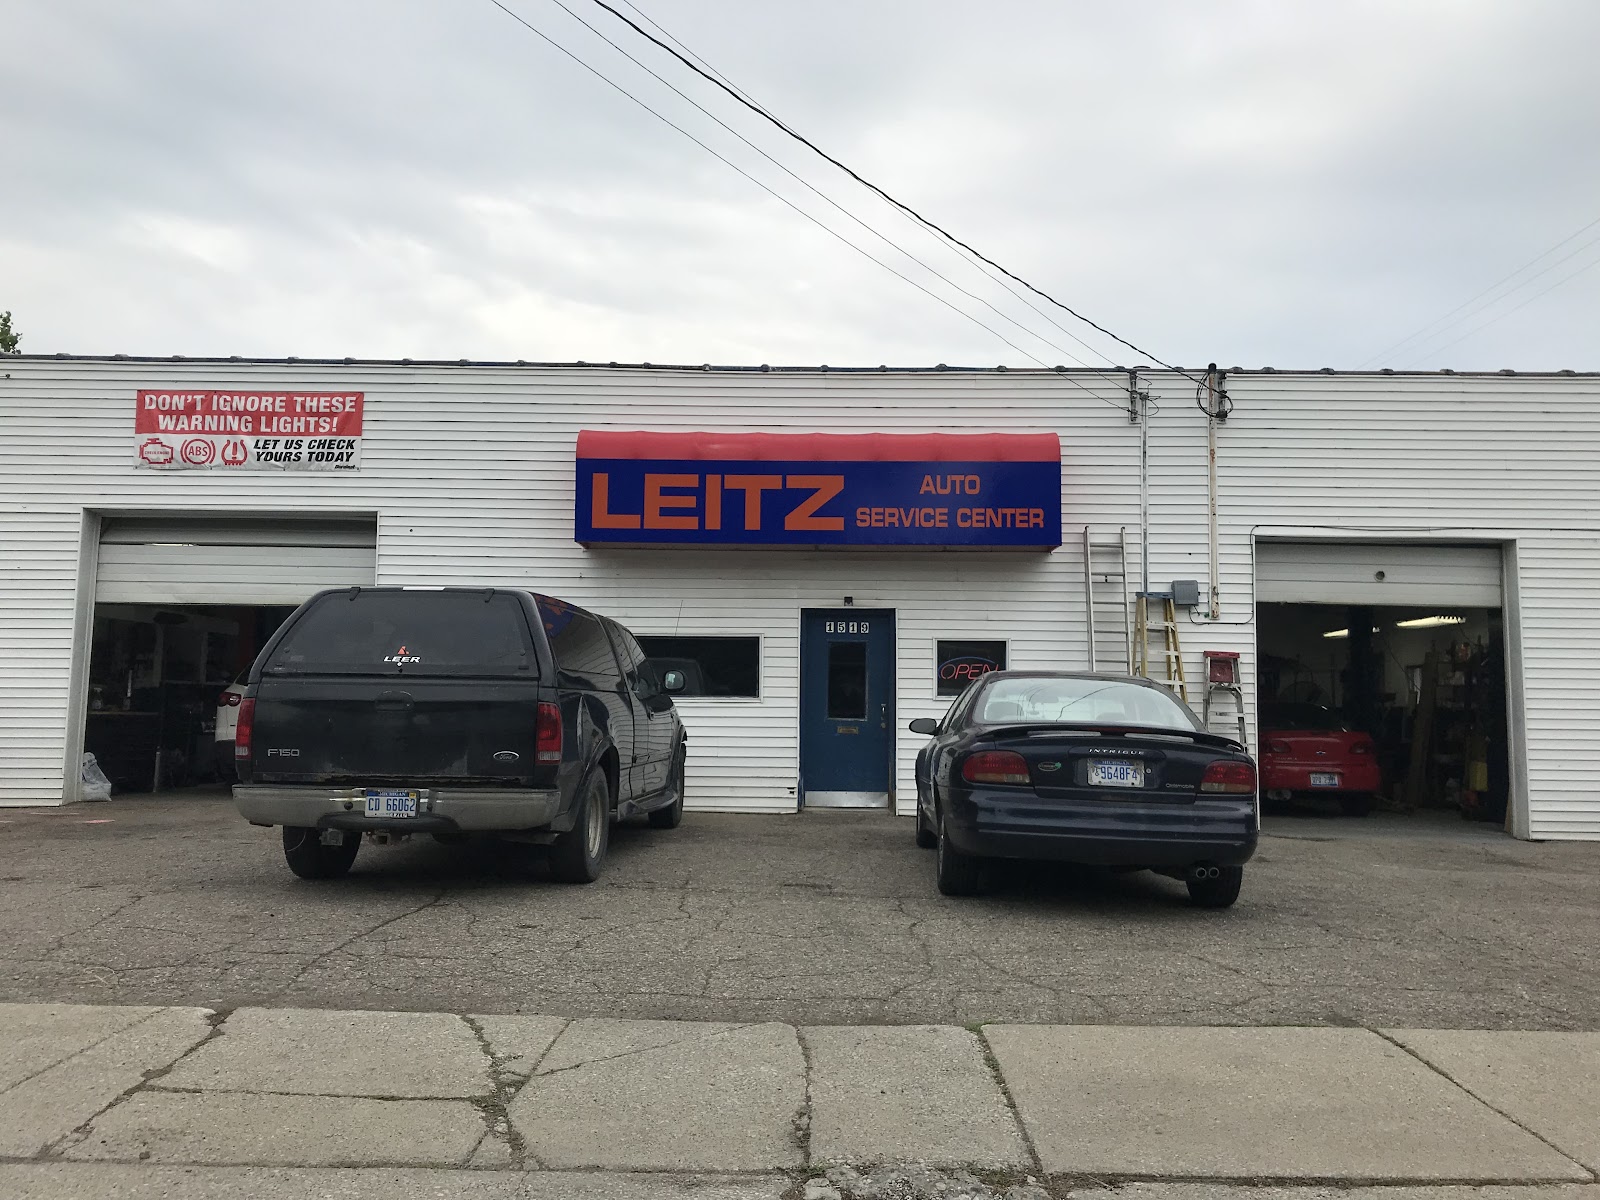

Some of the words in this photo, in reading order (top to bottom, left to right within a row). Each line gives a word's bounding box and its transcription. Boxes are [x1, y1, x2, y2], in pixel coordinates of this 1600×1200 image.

[144, 394, 205, 411] DON'T
[212, 395, 287, 412] IGNORE
[293, 396, 357, 413] THESE
[158, 415, 253, 432] WARNING
[260, 416, 338, 433] LIGHTS!
[188, 445, 208, 458] ABS
[253, 439, 281, 450] LET
[283, 439, 302, 450] US
[307, 439, 356, 450] CHECK
[255, 451, 301, 463] YOURS
[306, 451, 355, 463] TODAY
[919, 474, 980, 495] AUTO
[591, 472, 845, 531] LEITZ
[855, 508, 948, 528] SERVICE
[956, 508, 1044, 529] CENTER
[827, 622, 868, 633] 1519
[1100, 766, 1137, 780] 9648F4
[368, 797, 380, 811] CD
[386, 798, 416, 812] 66062
